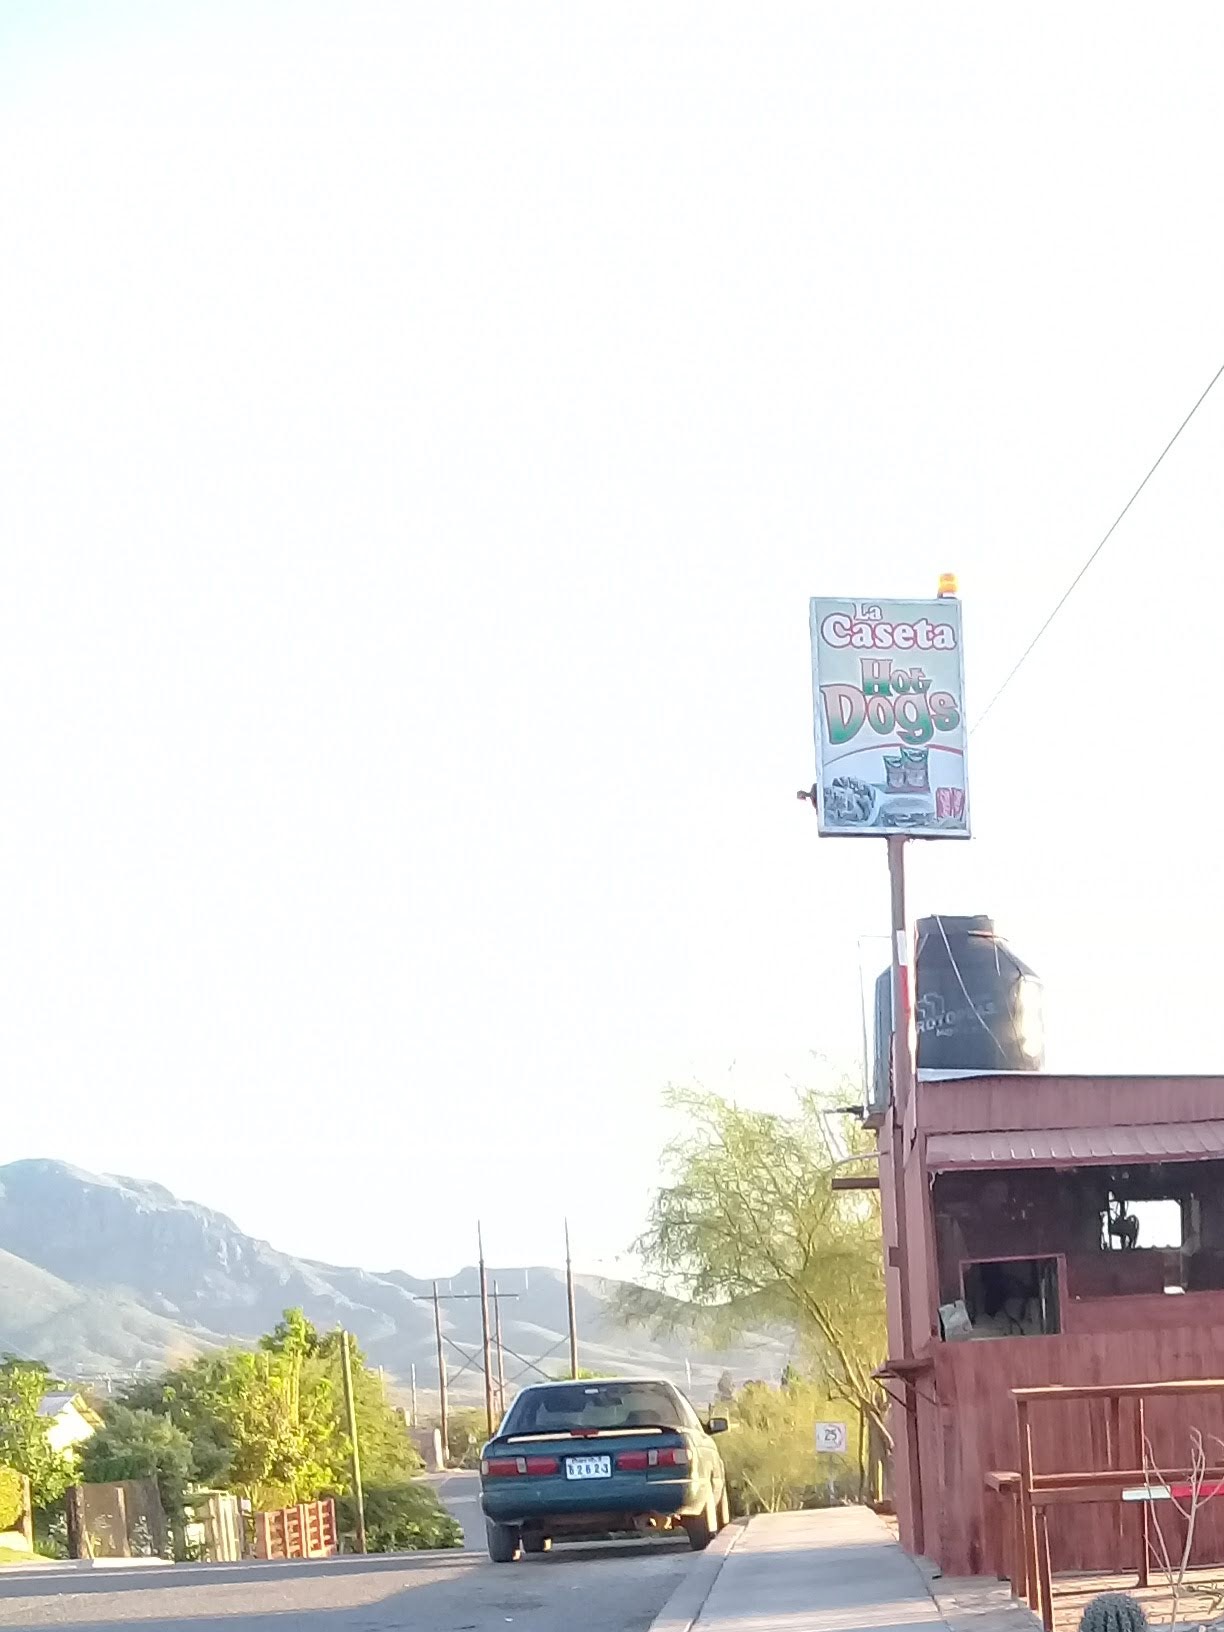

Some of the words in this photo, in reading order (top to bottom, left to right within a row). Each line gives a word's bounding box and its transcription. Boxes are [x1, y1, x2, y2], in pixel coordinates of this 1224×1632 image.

[852, 602, 883, 621] La
[821, 612, 957, 650] Caseta
[860, 658, 932, 696] Hot
[820, 684, 960, 745] Dogs
